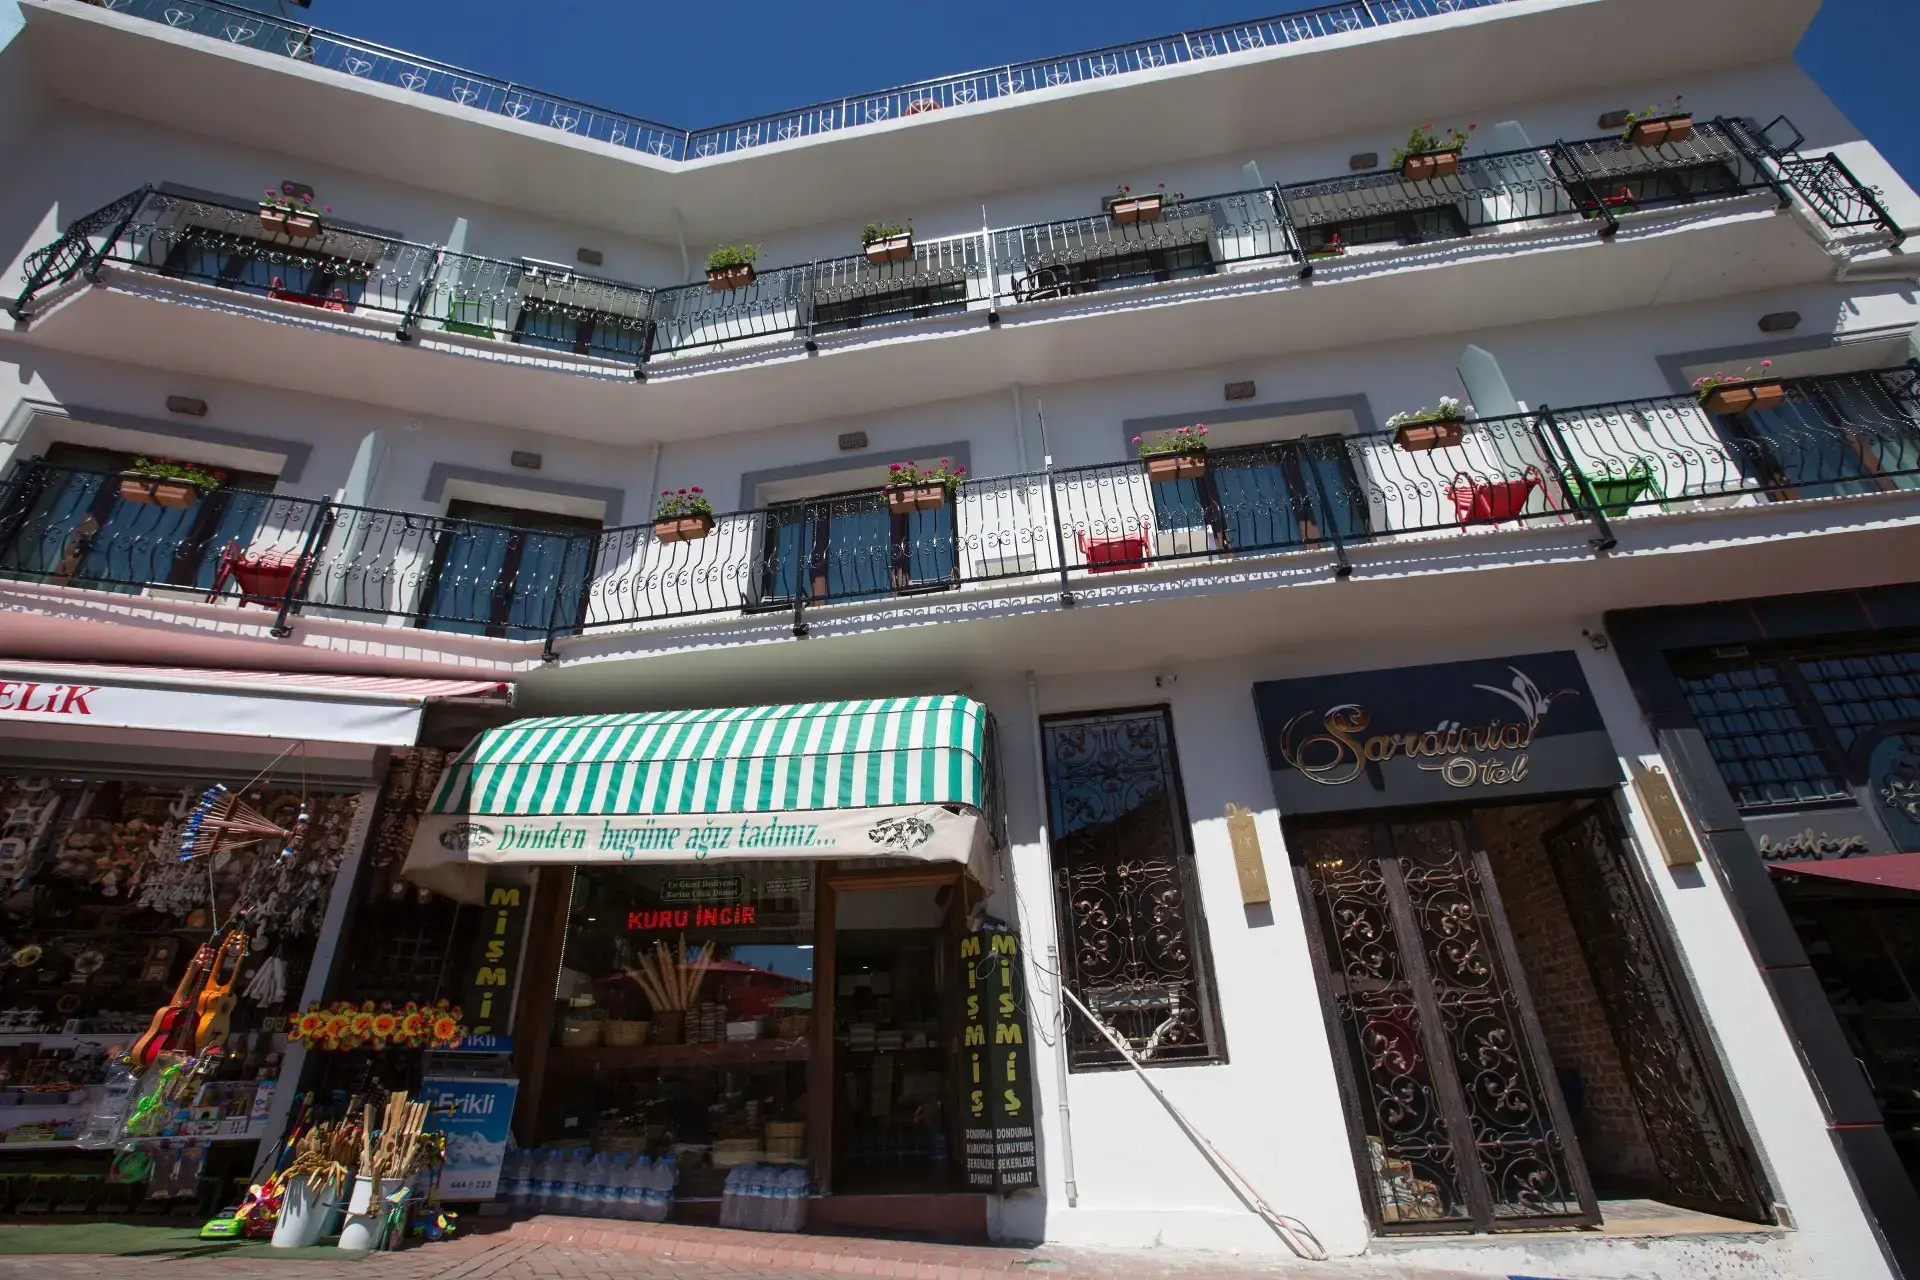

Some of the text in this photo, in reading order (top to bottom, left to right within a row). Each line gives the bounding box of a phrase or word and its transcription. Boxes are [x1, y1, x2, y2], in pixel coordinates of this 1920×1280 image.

[1280, 703, 1532, 785] Sardinia
[1418, 753, 1529, 787] Otel
[496, 820, 588, 851] Dünden
[599, 818, 681, 861] bugüne
[685, 817, 733, 860] ağız
[627, 909, 690, 930] KURU
[438, 1092, 496, 1115] Erikli
[996, 1126, 1033, 1139] DONDURMA
[1002, 1171, 1034, 1185] BAHARAT
